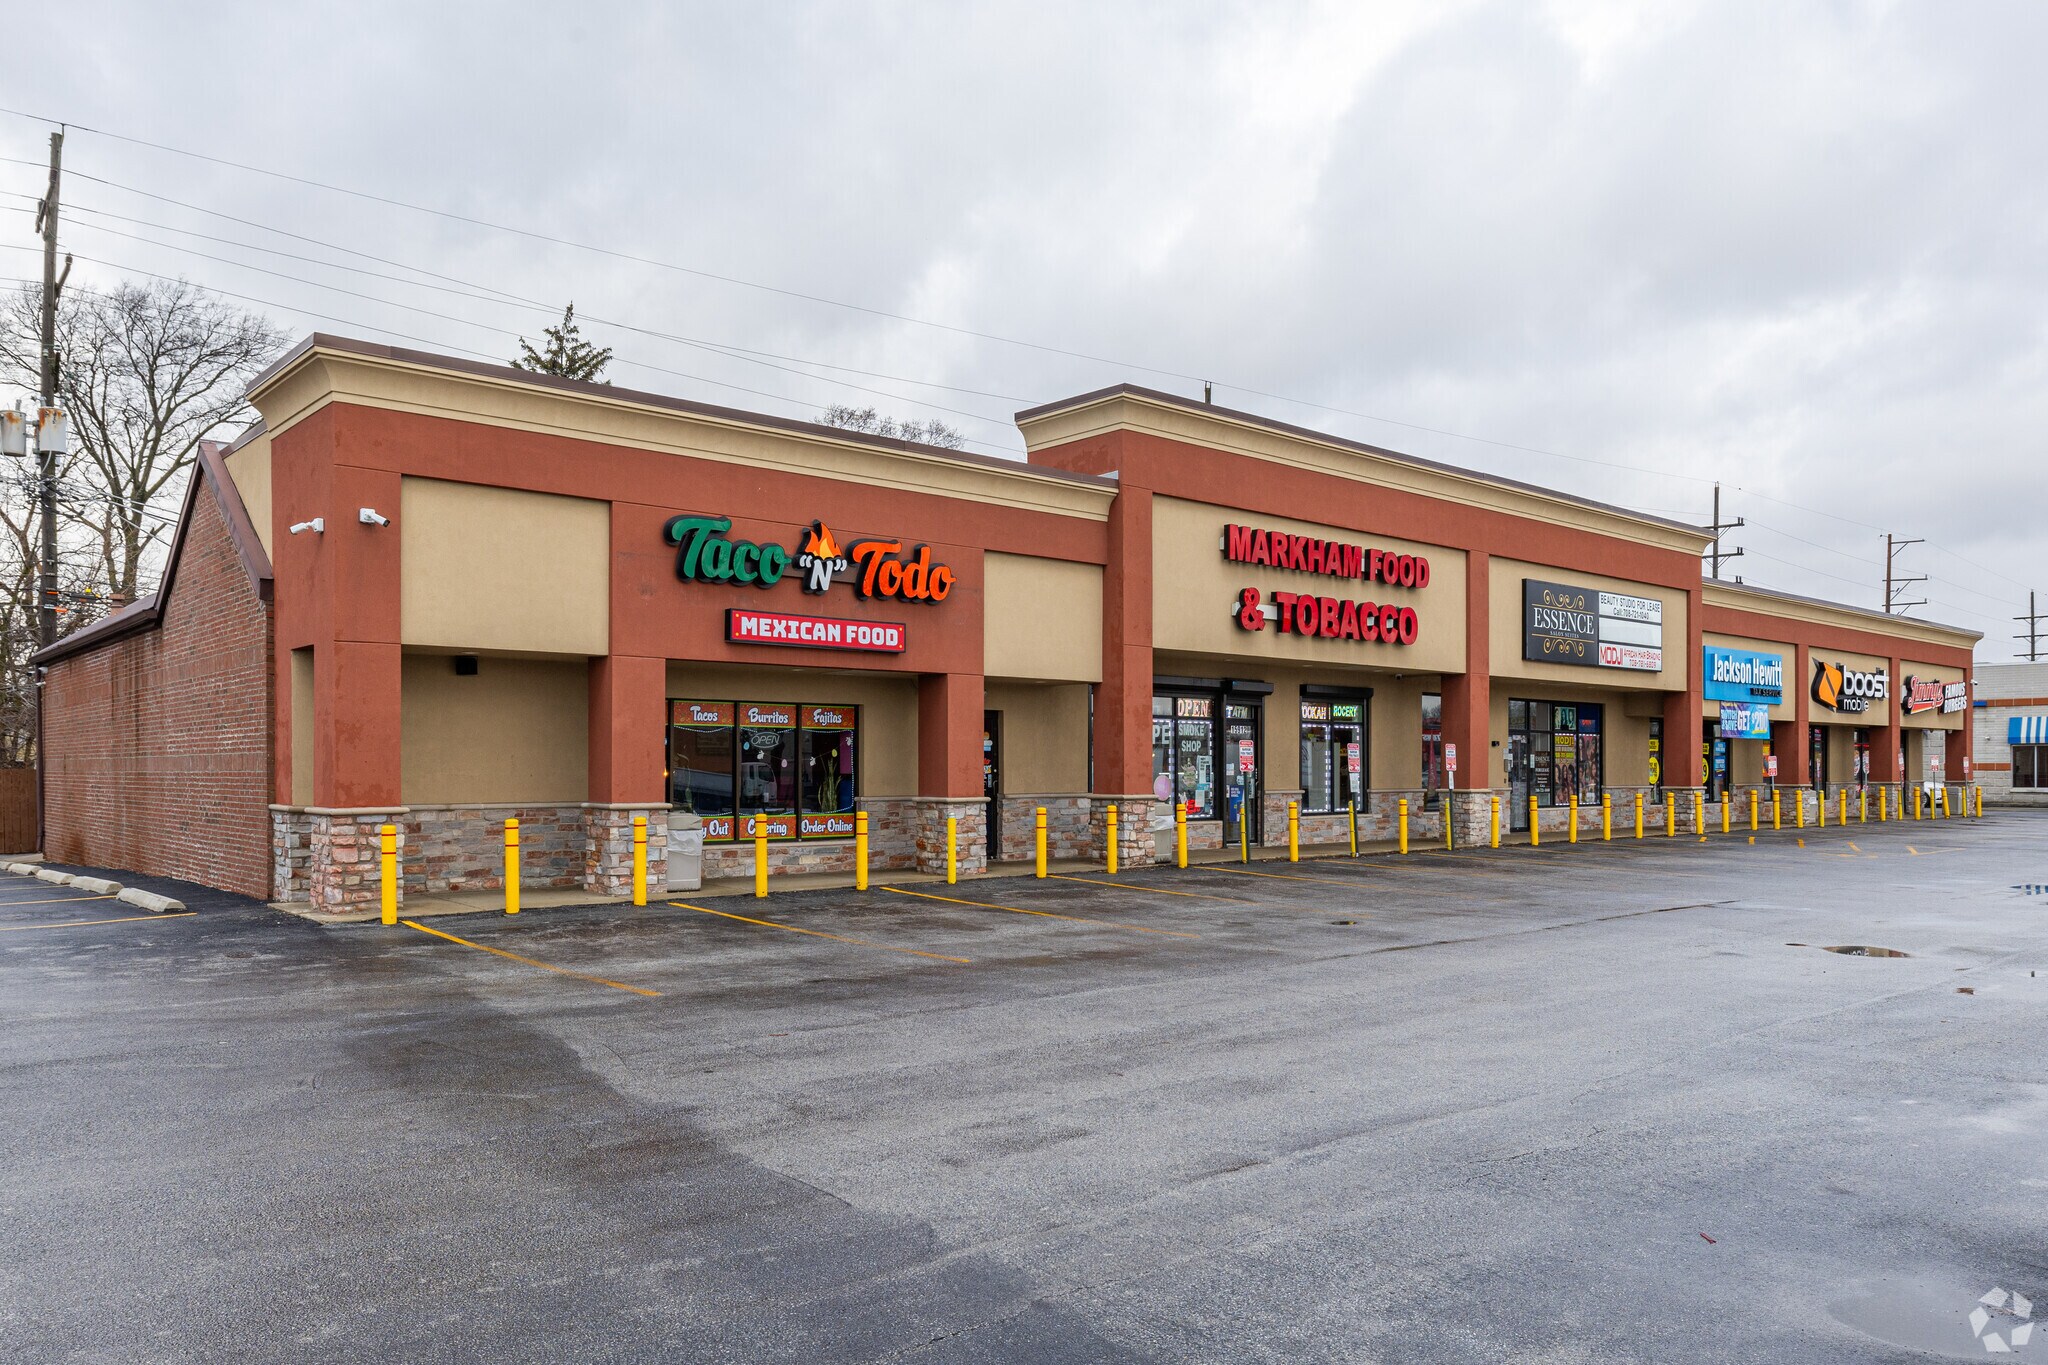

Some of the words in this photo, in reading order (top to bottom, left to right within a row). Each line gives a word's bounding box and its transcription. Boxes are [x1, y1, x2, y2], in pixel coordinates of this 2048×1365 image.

[664, 514, 793, 588] Taco
[848, 538, 957, 603] Todo
[1224, 523, 1362, 579] MARKHAM
[1364, 548, 1430, 588] FOOD
[1600, 594, 1619, 606] BEAUTY
[1620, 597, 1636, 609] STUDIO
[1637, 600, 1646, 611] FOR
[1646, 602, 1661, 613] LEASE
[1236, 587, 1266, 631] &
[1271, 591, 1418, 645] TOBACCO
[1533, 607, 1595, 635] ESSENCE
[741, 616, 840, 642] MEXICAN
[846, 625, 899, 646] FOOD
[1713, 653, 1752, 684] Jackson
[1753, 657, 1782, 687] Hewitt
[1843, 664, 1889, 699] boost
[1945, 682, 1966, 699] FAMOUS
[690, 705, 718, 722] Tacos
[1178, 698, 1210, 718] OPEN
[1301, 705, 1327, 720] OOKAH
[1333, 705, 1358, 717] ROCERY
[1843, 698, 1870, 711] mobile
[748, 707, 789, 724] Burritos
[813, 708, 842, 726] Fajitas
[1737, 710, 1750, 731] GET
[1178, 724, 1205, 737] SMOKE
[751, 734, 780, 746] OPEN
[1182, 740, 1202, 752] SHOP
[709, 819, 729, 837] Out
[747, 818, 788, 837] Cering
[801, 818, 826, 834] Order
[827, 818, 853, 833] Online
